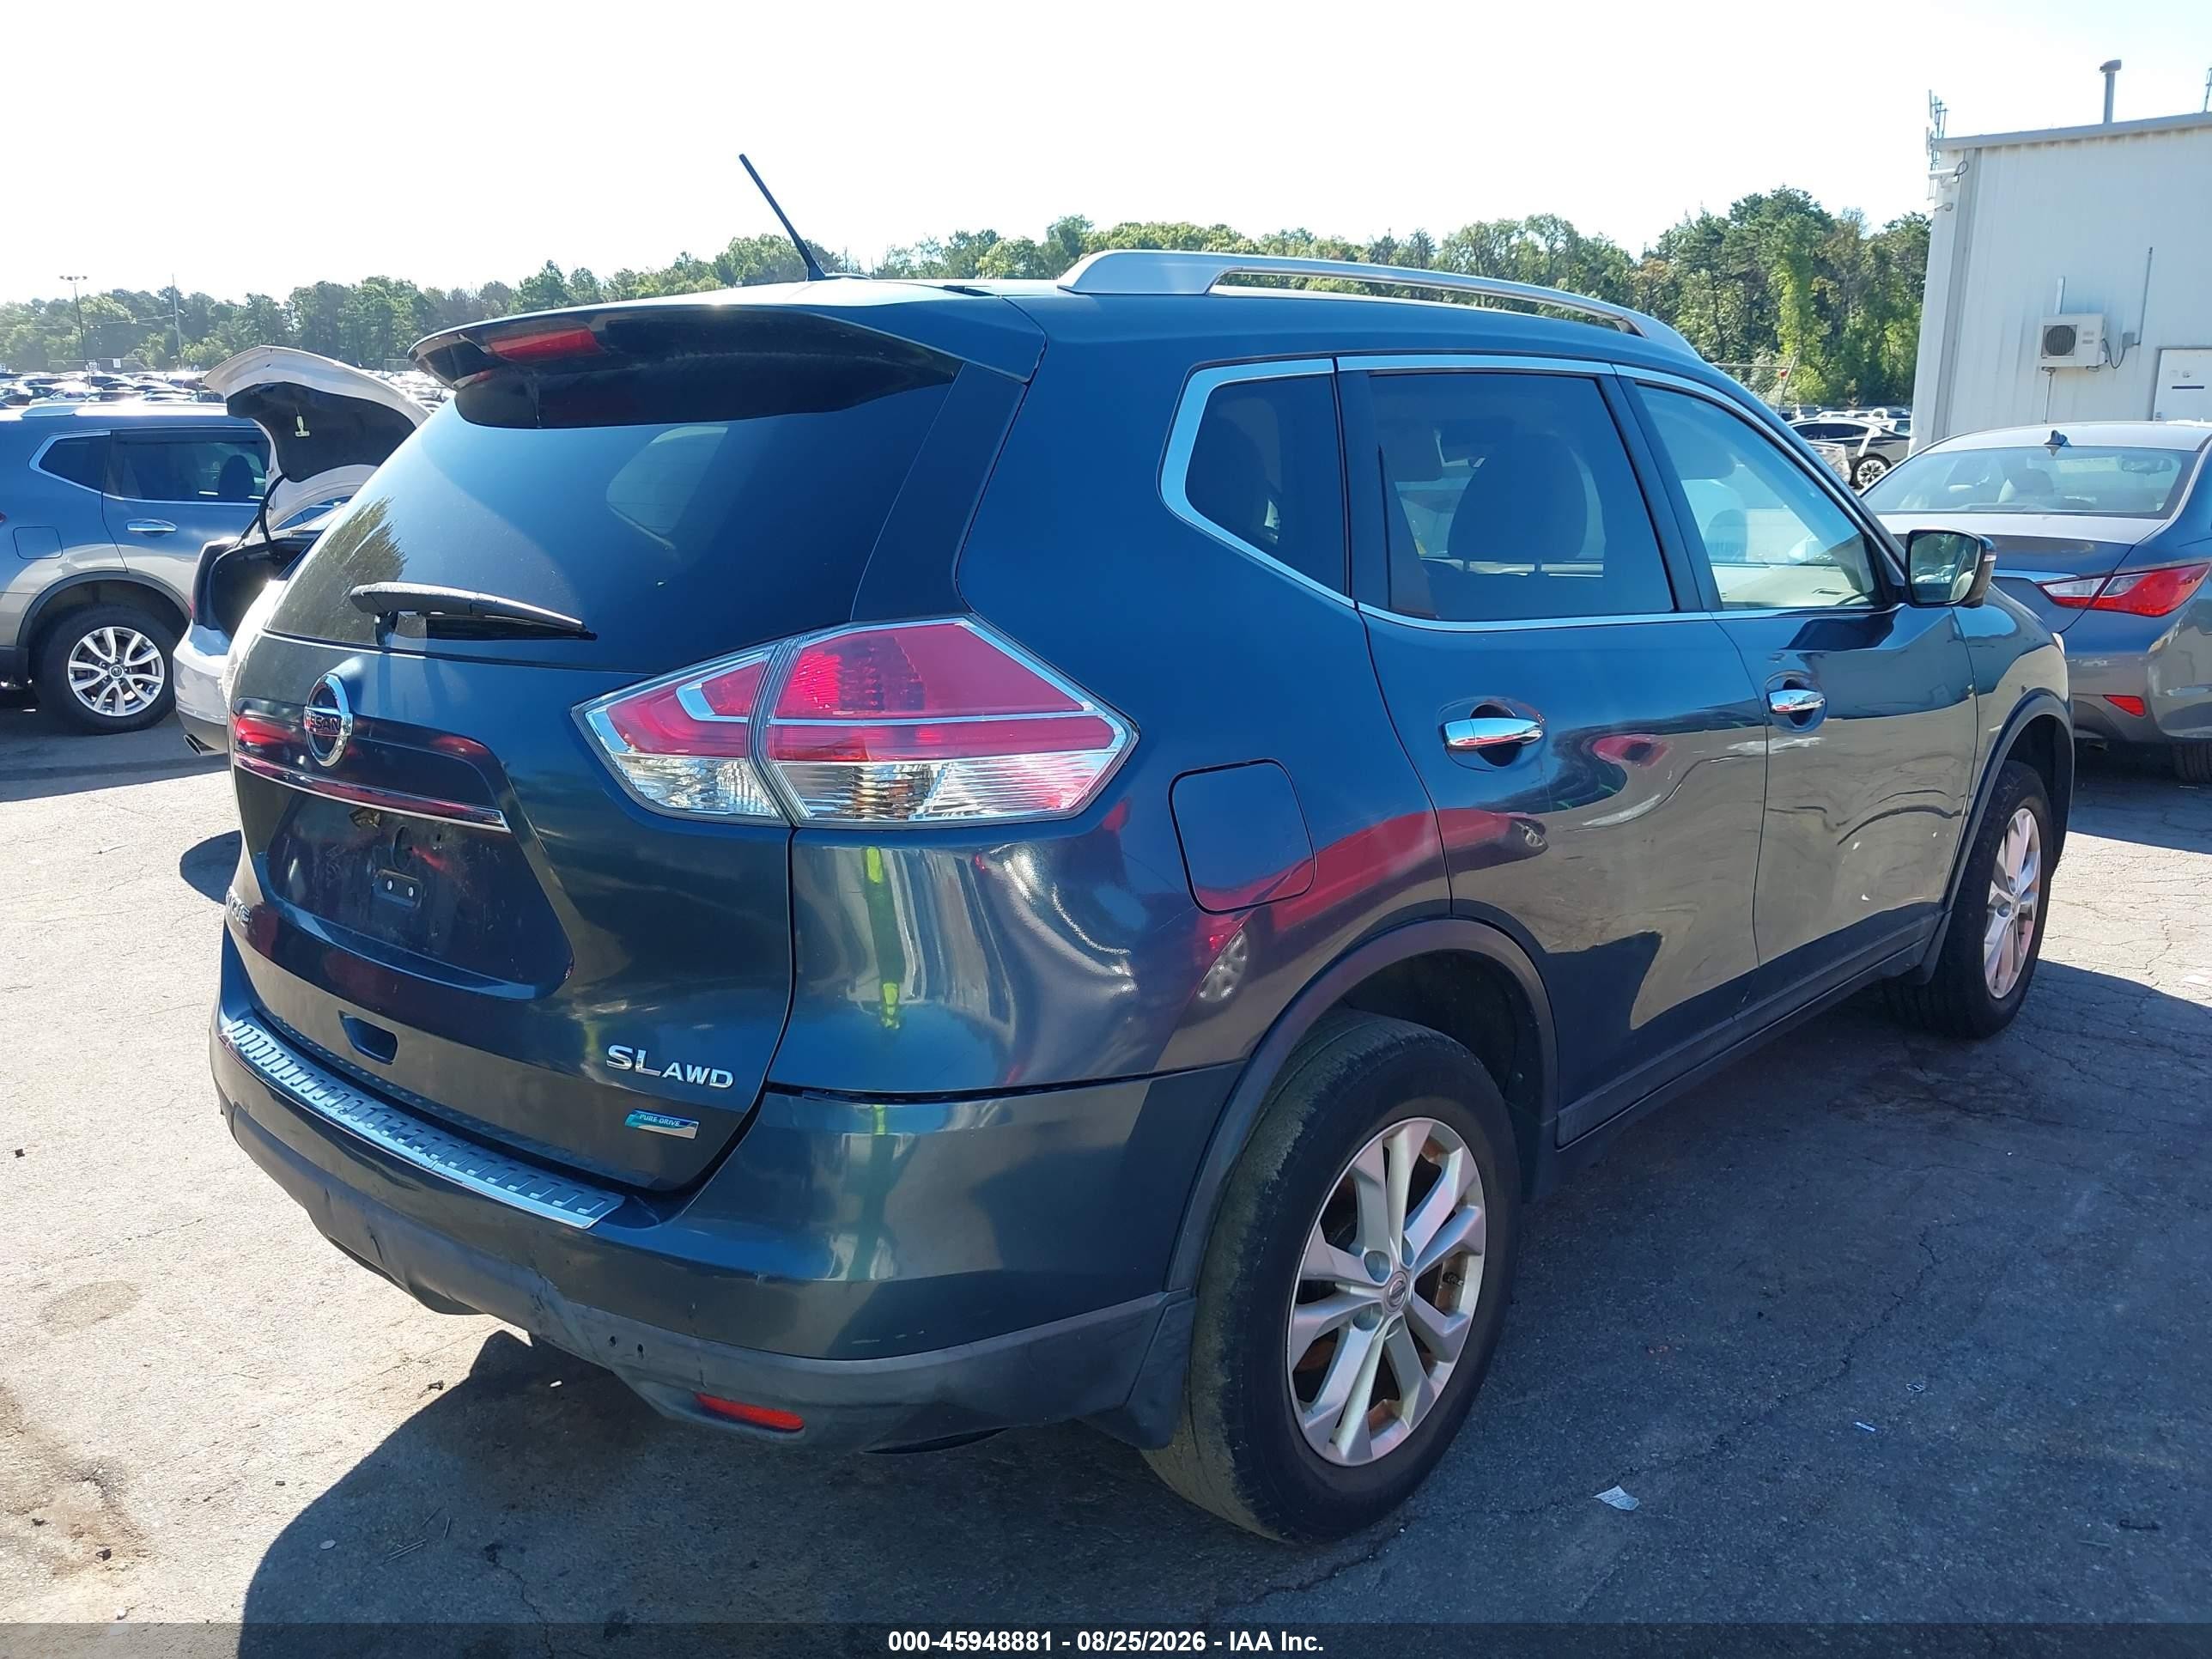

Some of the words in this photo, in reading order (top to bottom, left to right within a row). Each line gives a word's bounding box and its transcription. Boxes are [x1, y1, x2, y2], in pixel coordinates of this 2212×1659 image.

[605, 1044, 661, 1077] SL
[661, 1061, 734, 1089] AWD
[659, 1118, 681, 1127] DRIVE
